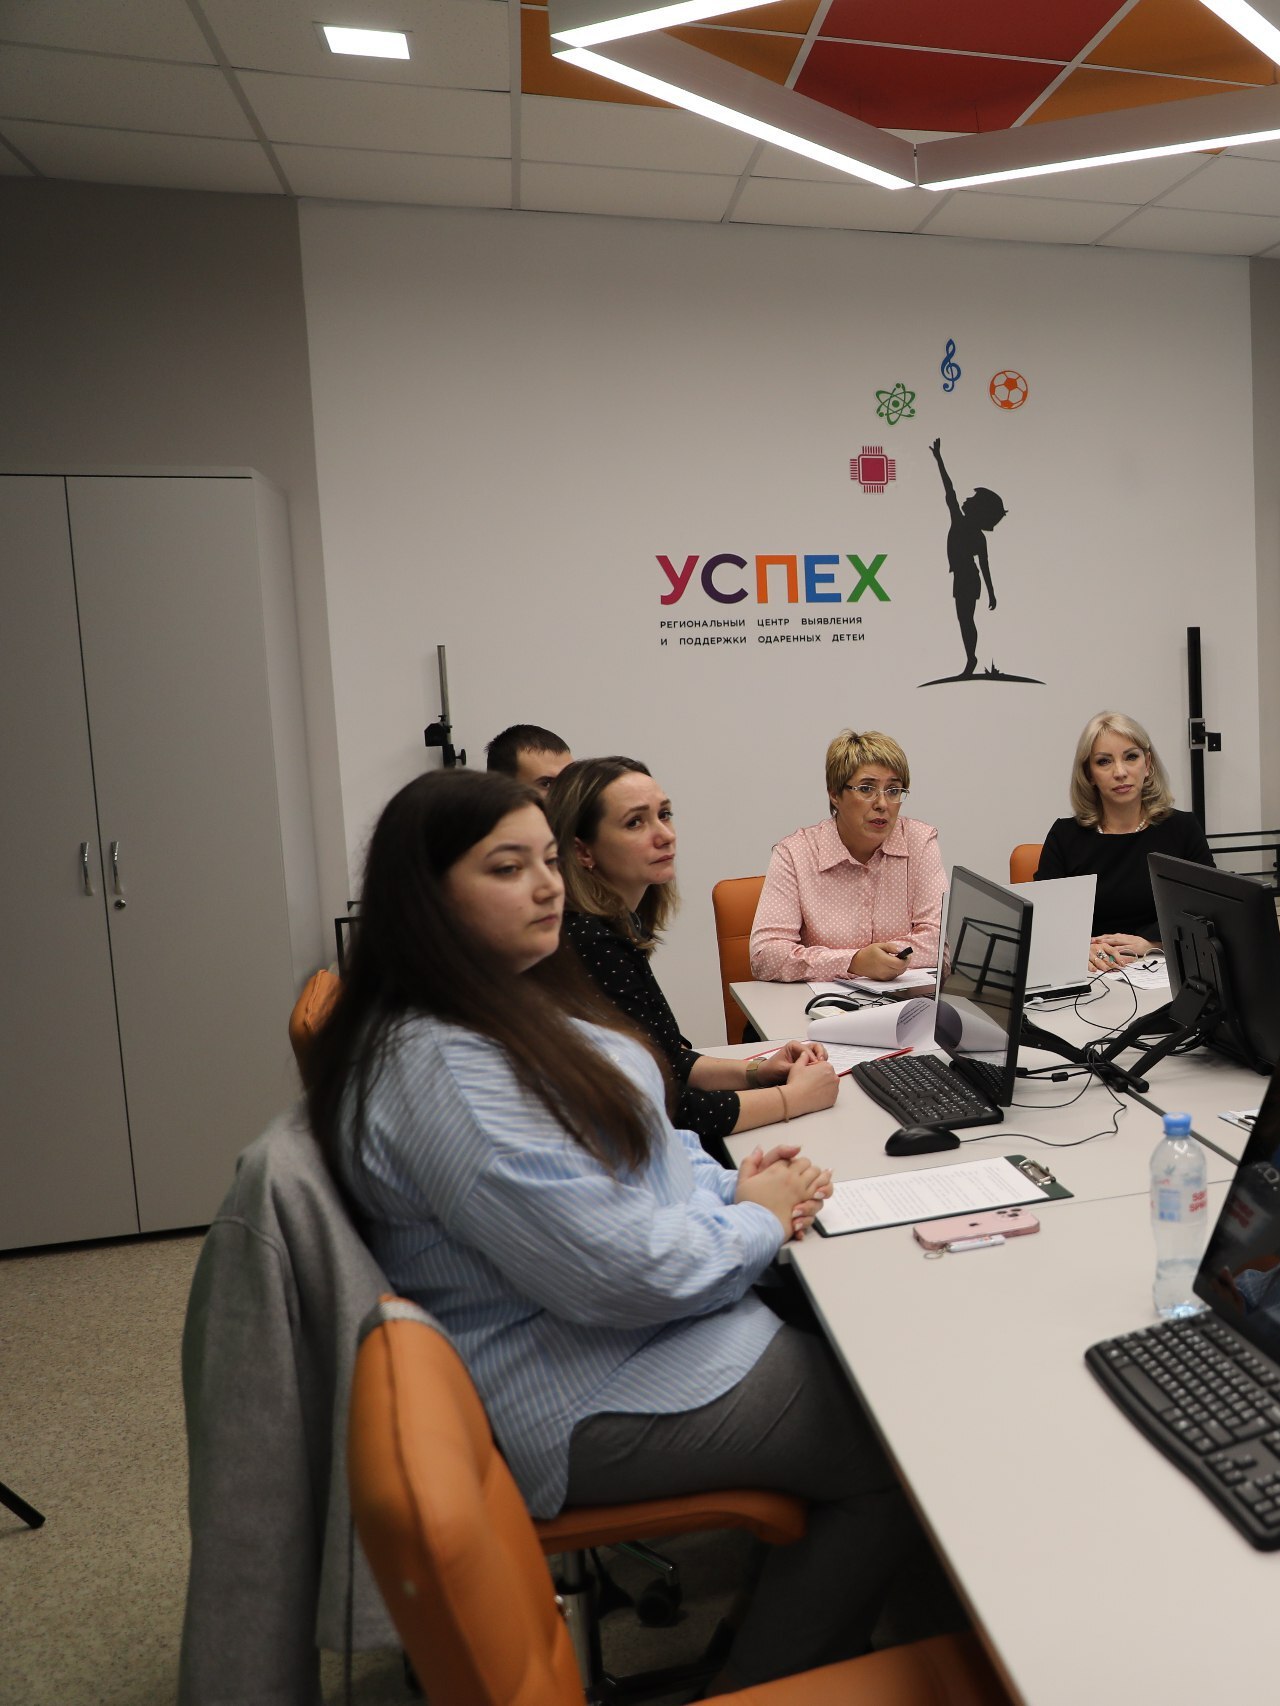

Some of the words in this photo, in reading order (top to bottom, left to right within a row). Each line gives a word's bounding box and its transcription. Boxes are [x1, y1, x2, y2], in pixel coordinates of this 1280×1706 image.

[655, 553, 892, 606] УСПЕХ
[757, 618, 790, 628] ЦЕНТР
[801, 616, 863, 626] ВЫЯВЛЕНИЯ
[660, 637, 669, 646] И
[679, 635, 747, 646] ПОДДЕРЖКИ
[757, 634, 822, 645] ОДАРЕННЫХ
